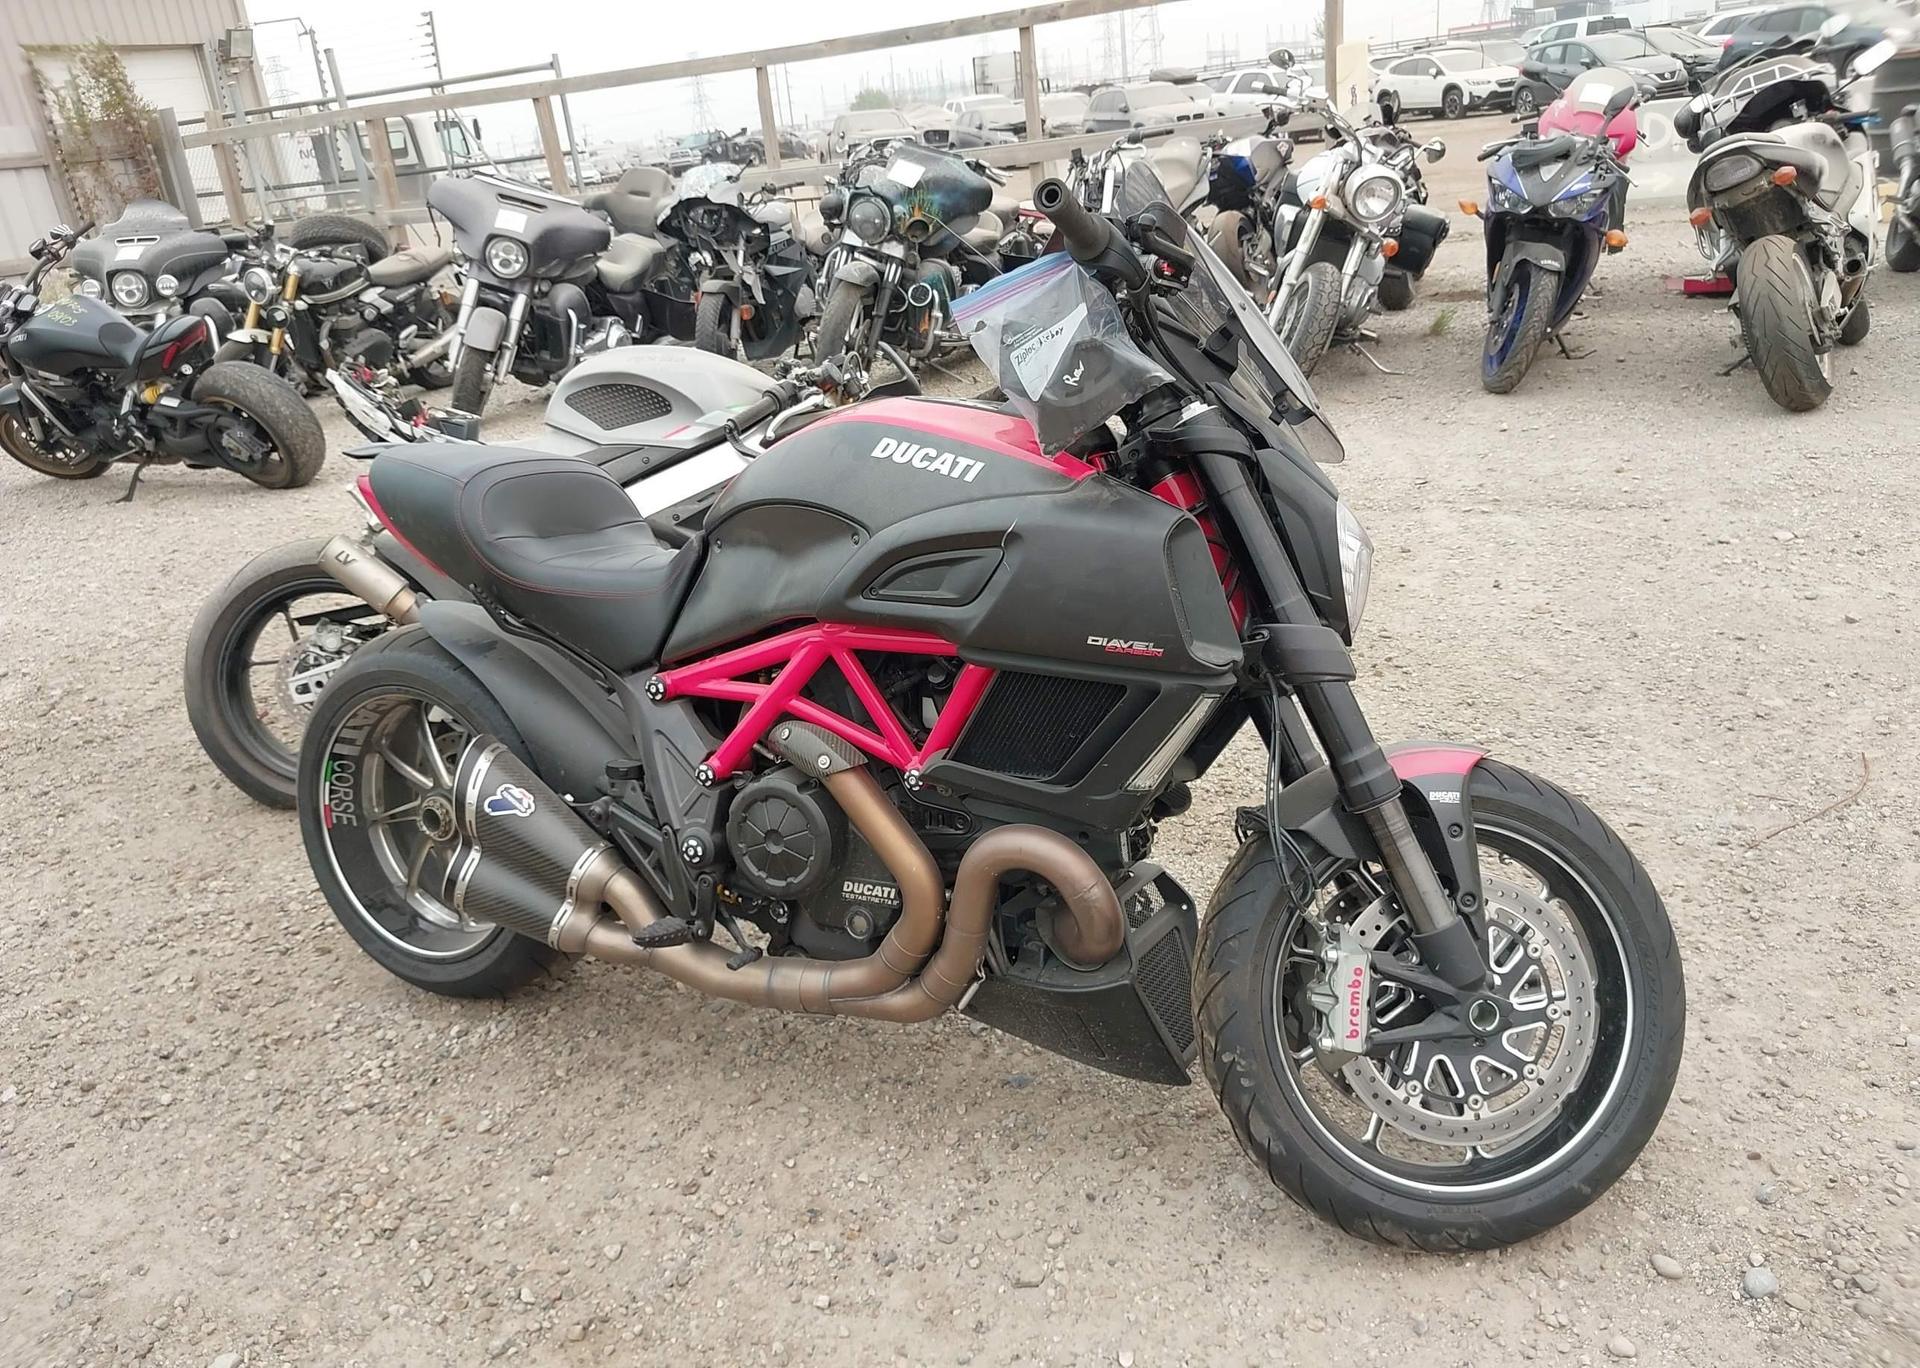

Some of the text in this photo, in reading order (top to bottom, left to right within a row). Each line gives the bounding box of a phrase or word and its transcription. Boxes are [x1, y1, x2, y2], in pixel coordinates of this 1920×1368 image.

[1014, 343, 1036, 366] Ziploc
[870, 437, 986, 483] DUCATI
[1087, 635, 1164, 652] DIAVEL
[1104, 646, 1165, 657] CARBON
[330, 760, 358, 827] CORSE
[841, 892, 892, 905] TESTASTRETTA
[842, 880, 896, 899] DUCATI
[1345, 967, 1363, 1039] brembo
